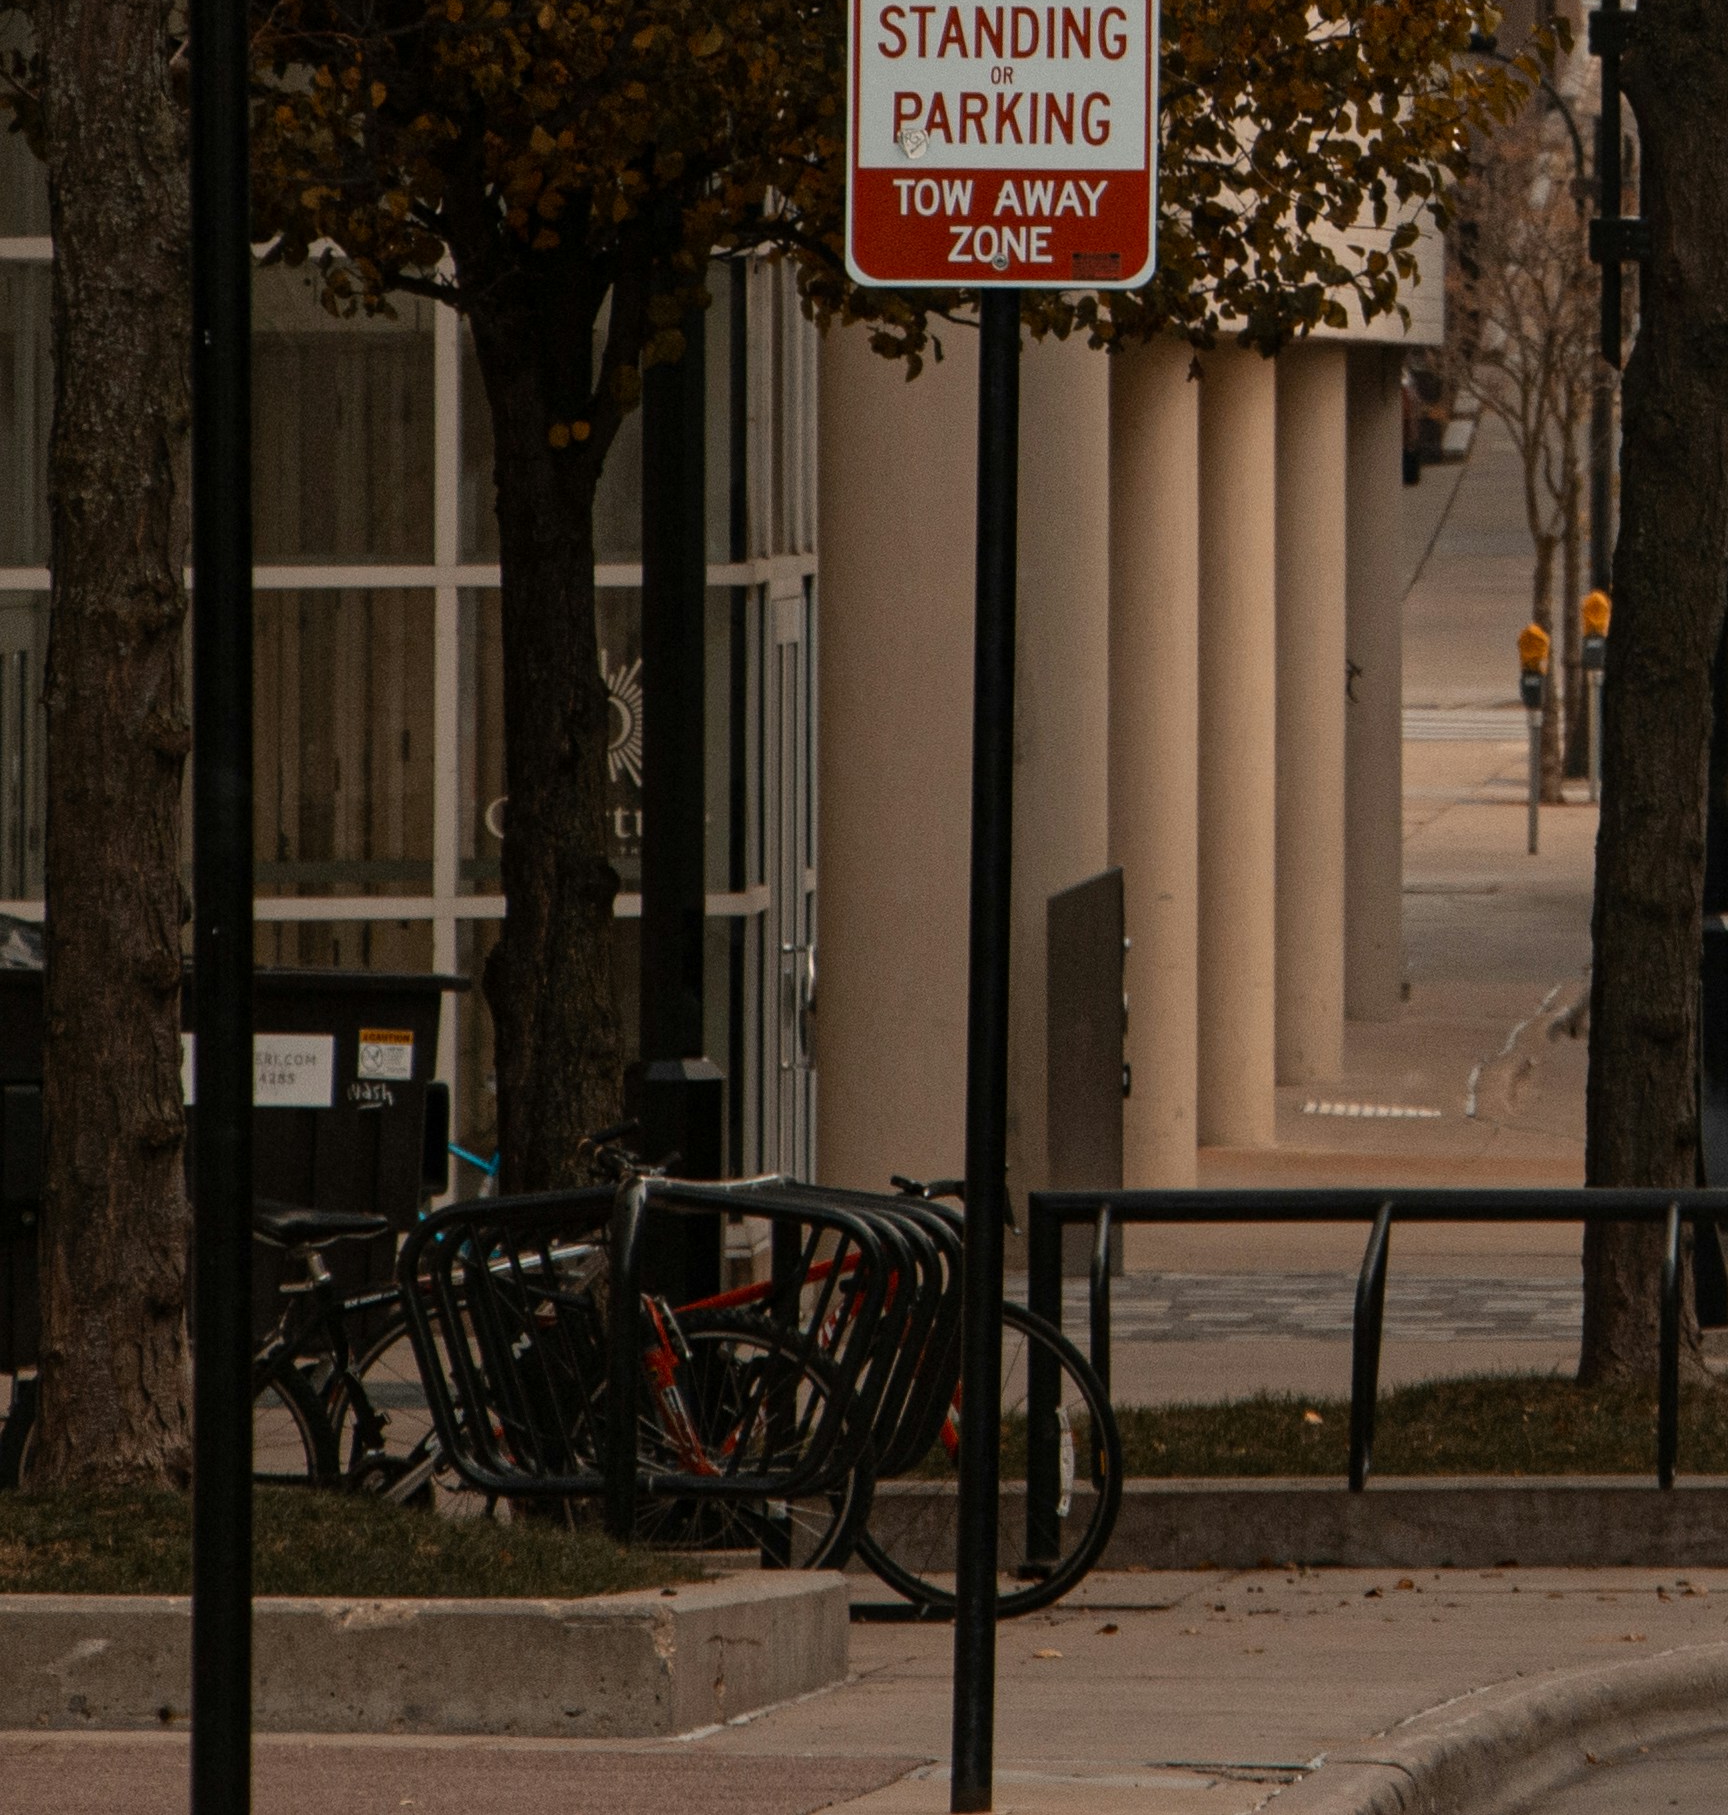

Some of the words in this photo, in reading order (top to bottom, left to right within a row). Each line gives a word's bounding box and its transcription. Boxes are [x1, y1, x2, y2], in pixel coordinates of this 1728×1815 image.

[878, 5, 1127, 60] STANDING
[991, 66, 1013, 85] OR
[894, 92, 1111, 146] PARKING
[893, 179, 973, 217] TOW
[994, 181, 1108, 217] AWAY
[948, 226, 1053, 263] ZONE
